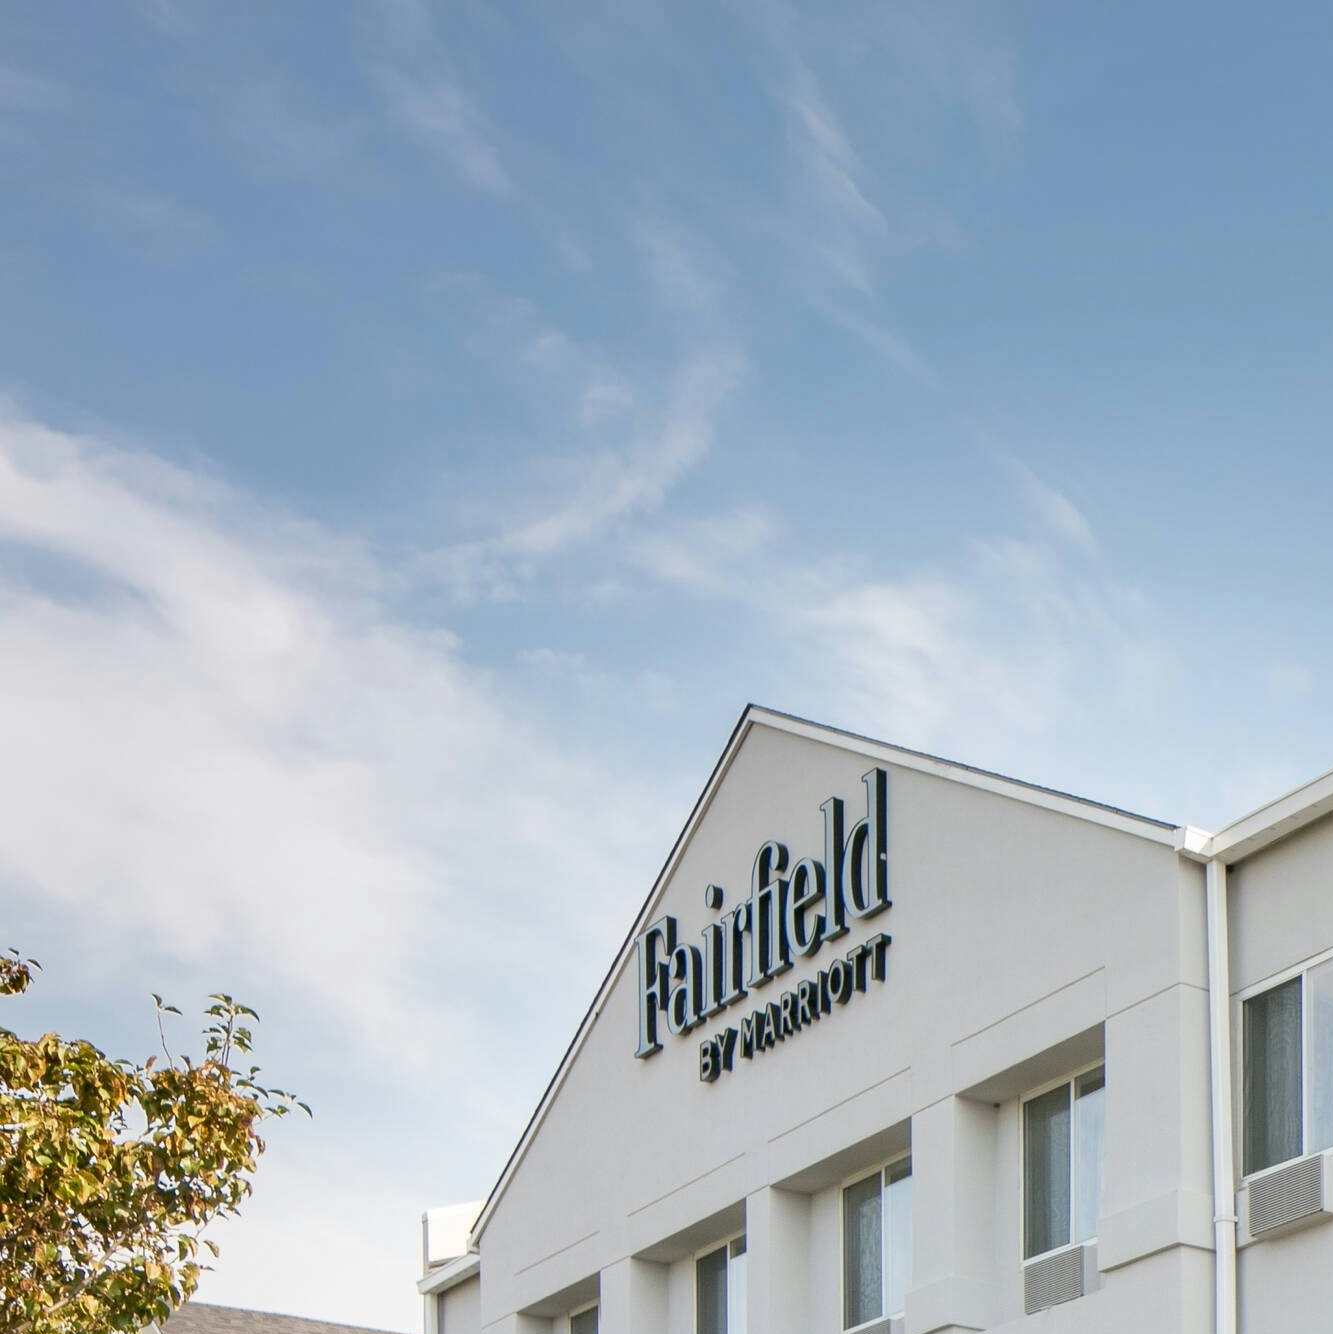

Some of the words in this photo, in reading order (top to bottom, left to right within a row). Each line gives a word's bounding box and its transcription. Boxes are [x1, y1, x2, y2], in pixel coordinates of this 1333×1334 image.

[634, 767, 892, 1060] Fairfield
[700, 1027, 738, 1082] BY
[740, 933, 892, 1059] MARRIOTT
